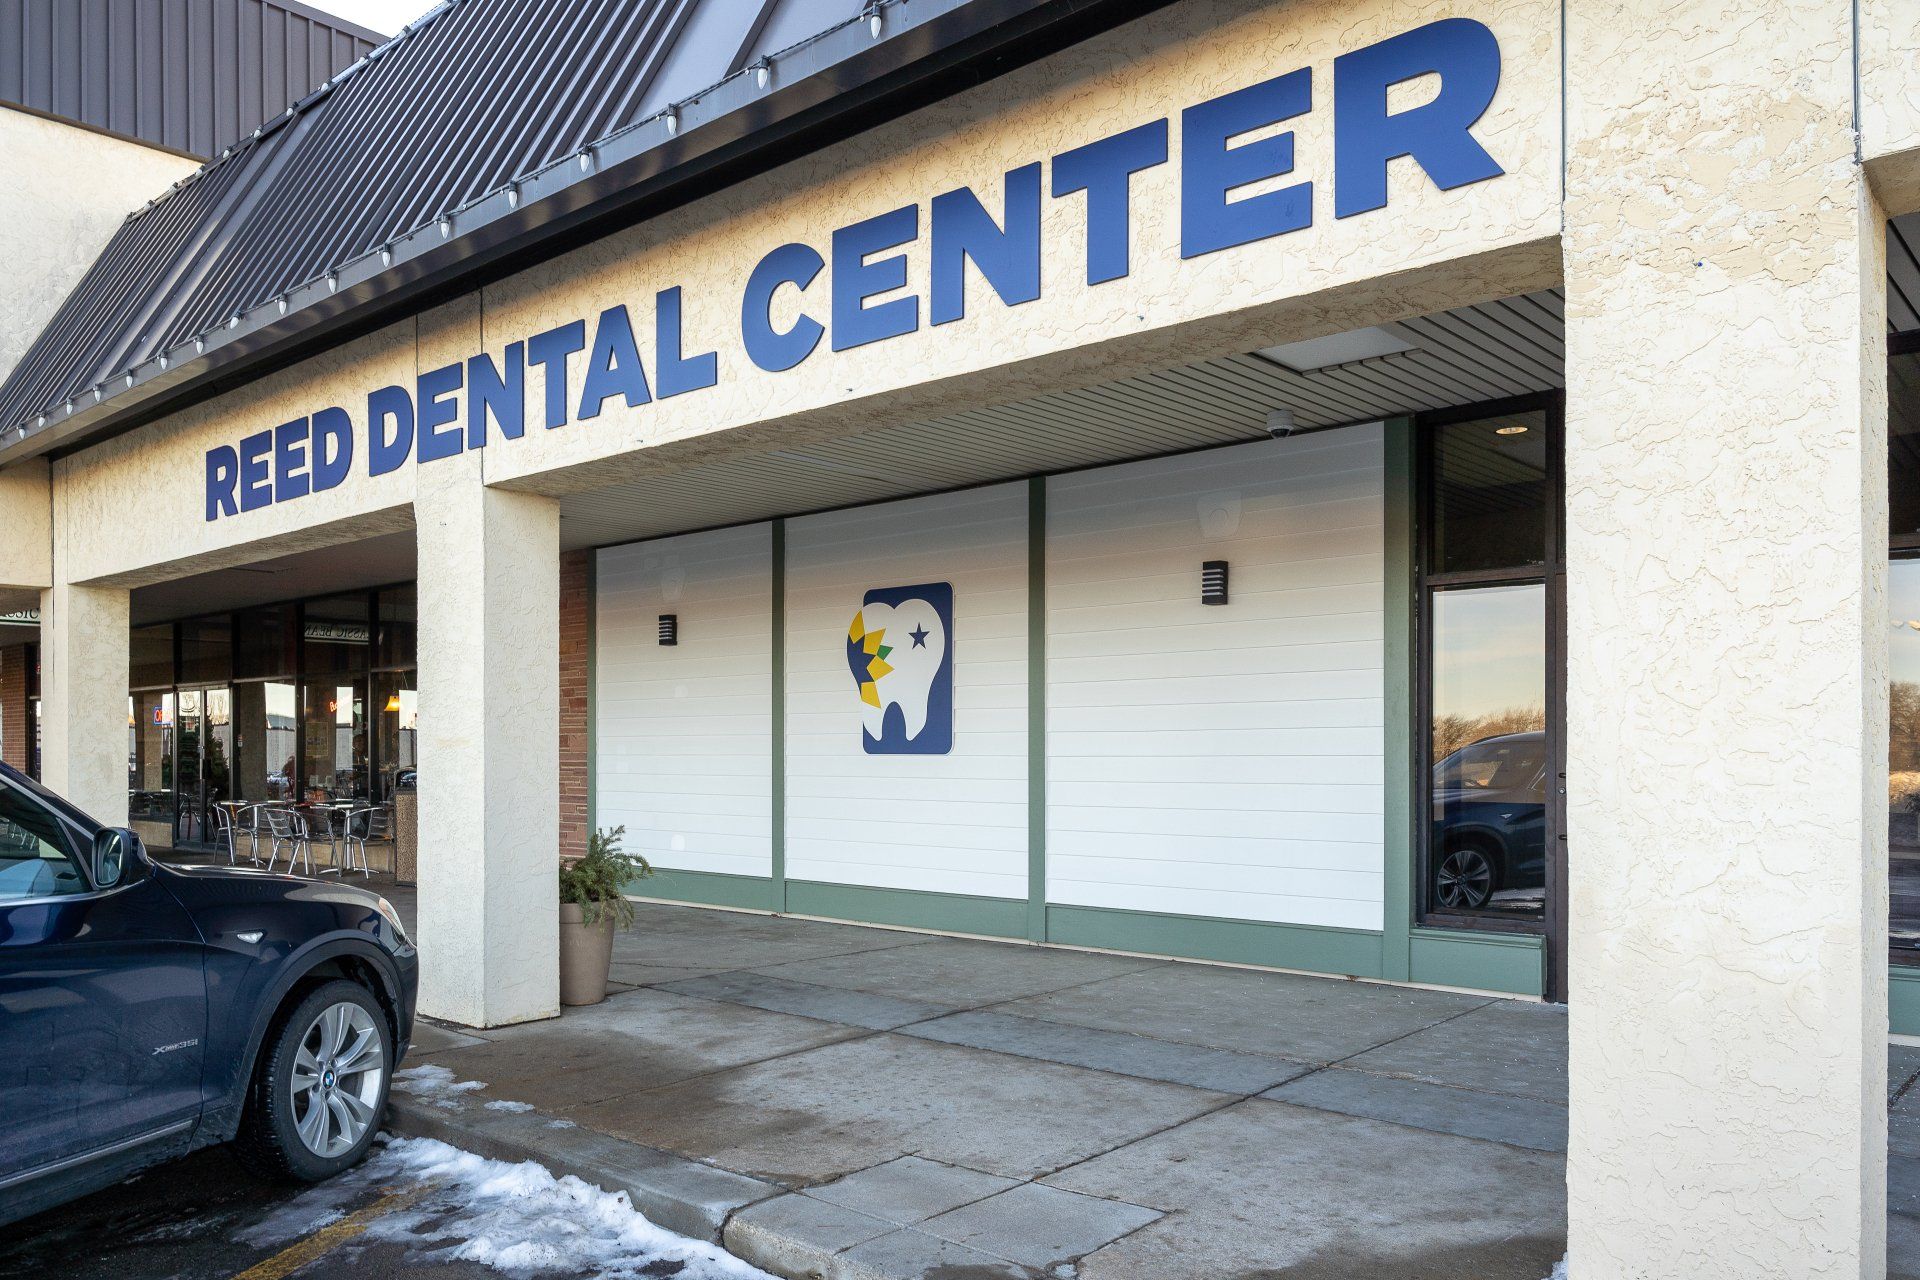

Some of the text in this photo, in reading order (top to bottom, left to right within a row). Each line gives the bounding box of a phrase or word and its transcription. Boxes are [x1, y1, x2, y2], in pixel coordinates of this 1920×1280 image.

[206, 17, 1504, 522] REED DENTAL CENTER
